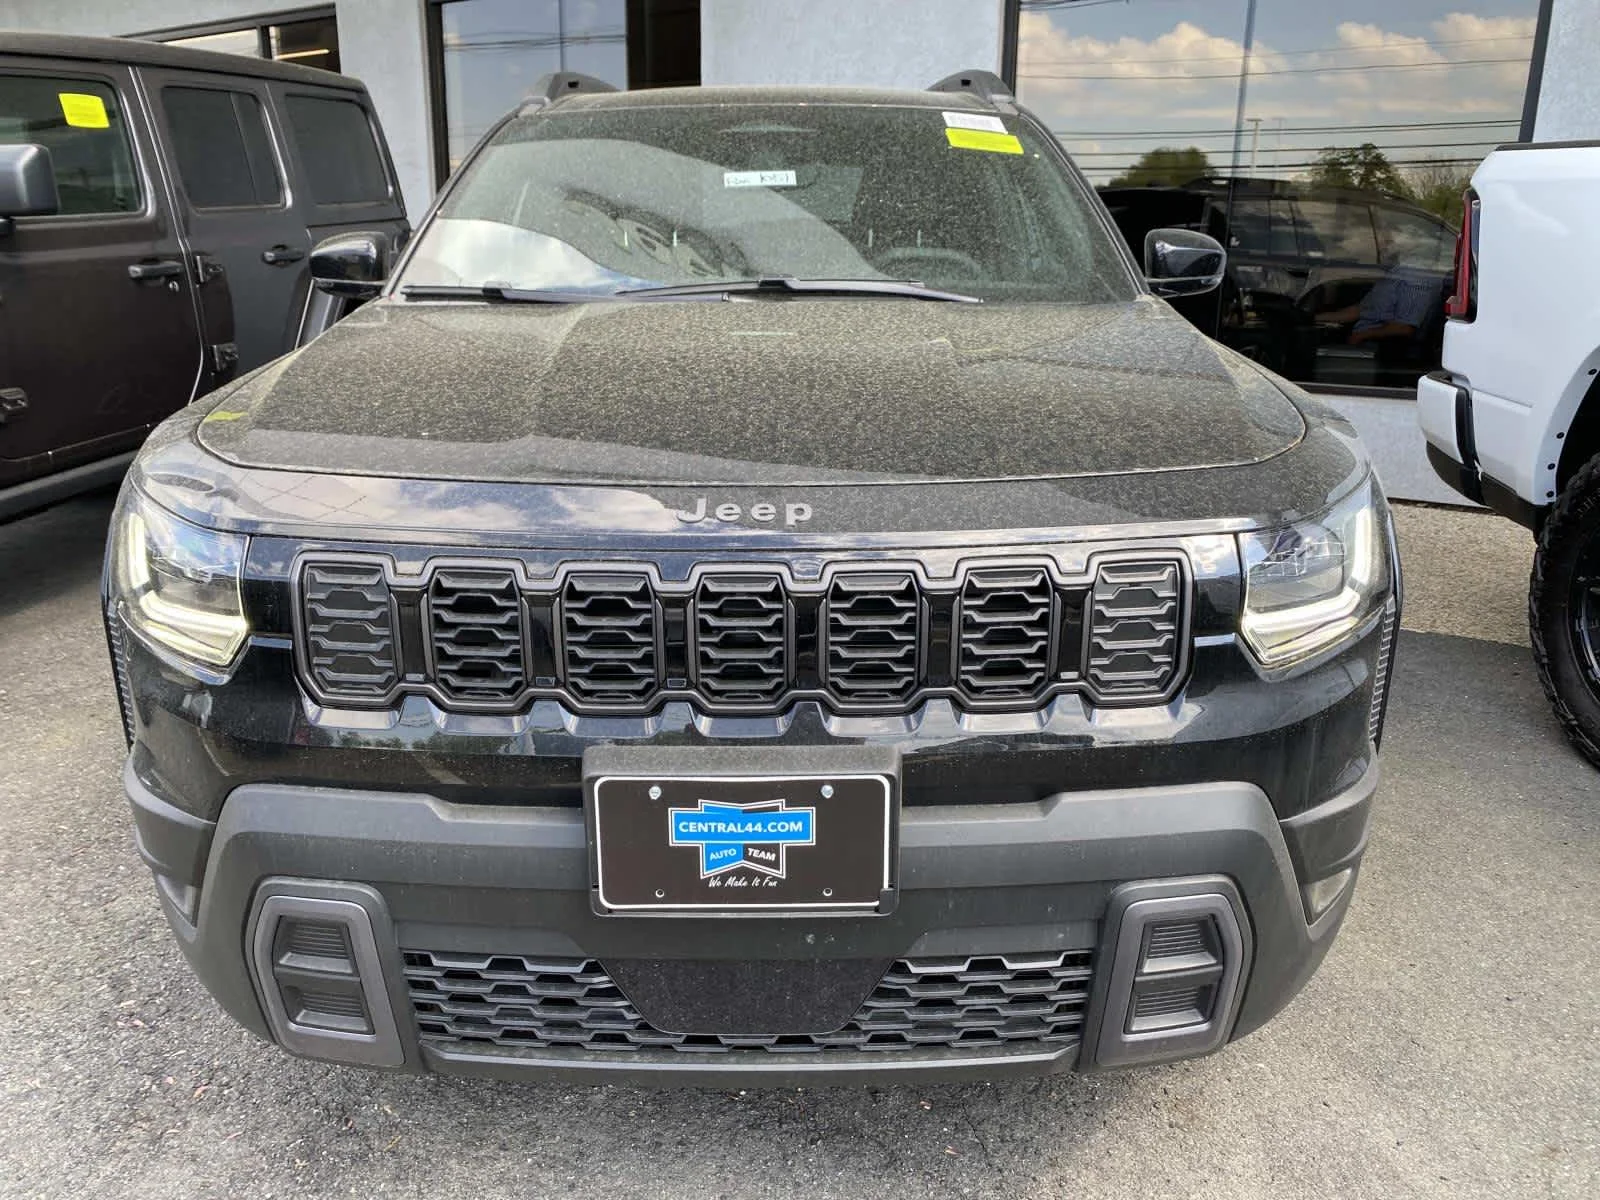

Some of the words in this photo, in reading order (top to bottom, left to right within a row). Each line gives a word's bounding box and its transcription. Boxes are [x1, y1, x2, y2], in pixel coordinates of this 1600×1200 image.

[676, 497, 812, 527] Jeep
[678, 820, 803, 834] CENTRAL44.COM
[709, 847, 737, 861] AUTO
[747, 847, 776, 862] TEAM
[708, 876, 722, 888] We
[724, 876, 748, 888] Make
[762, 876, 778, 887] Fun
